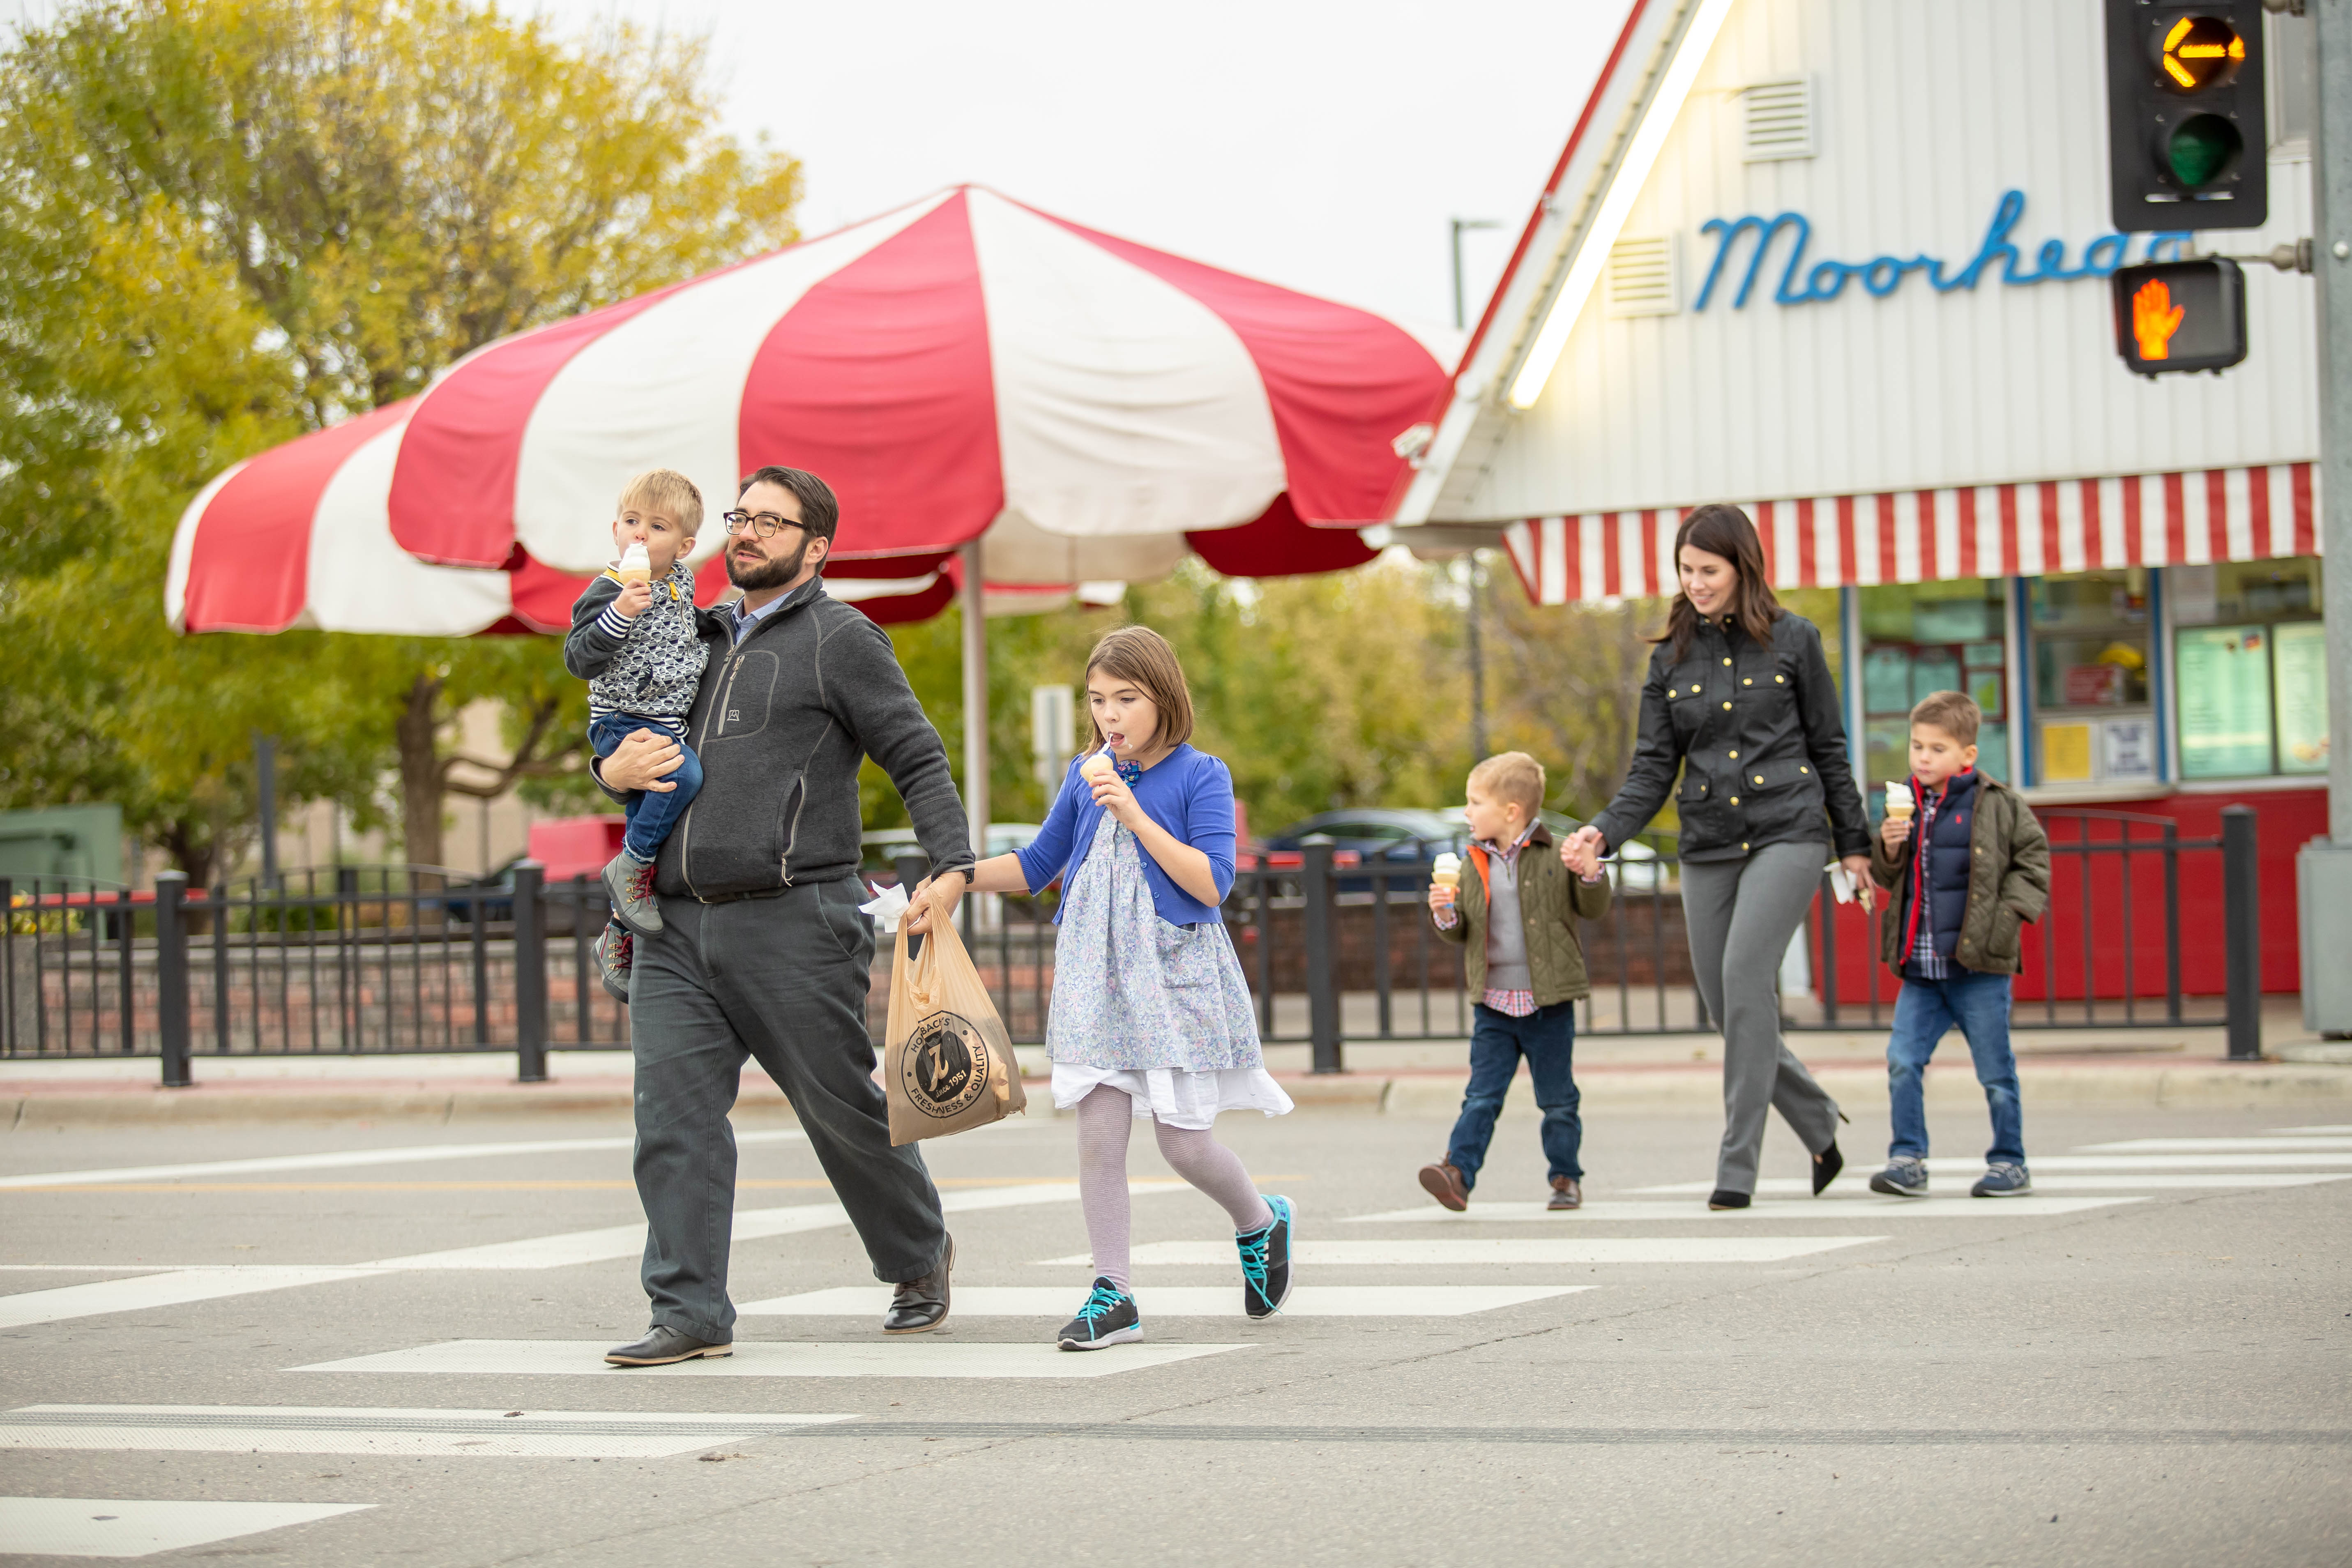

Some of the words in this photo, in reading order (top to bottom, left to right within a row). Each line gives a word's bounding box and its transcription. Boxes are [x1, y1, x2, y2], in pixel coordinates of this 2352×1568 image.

[911, 1088, 963, 1114] FRESHNESS
[971, 1046, 984, 1091] QUALITY
[935, 1085, 950, 1098] ince
[949, 1069, 966, 1087] 1951
